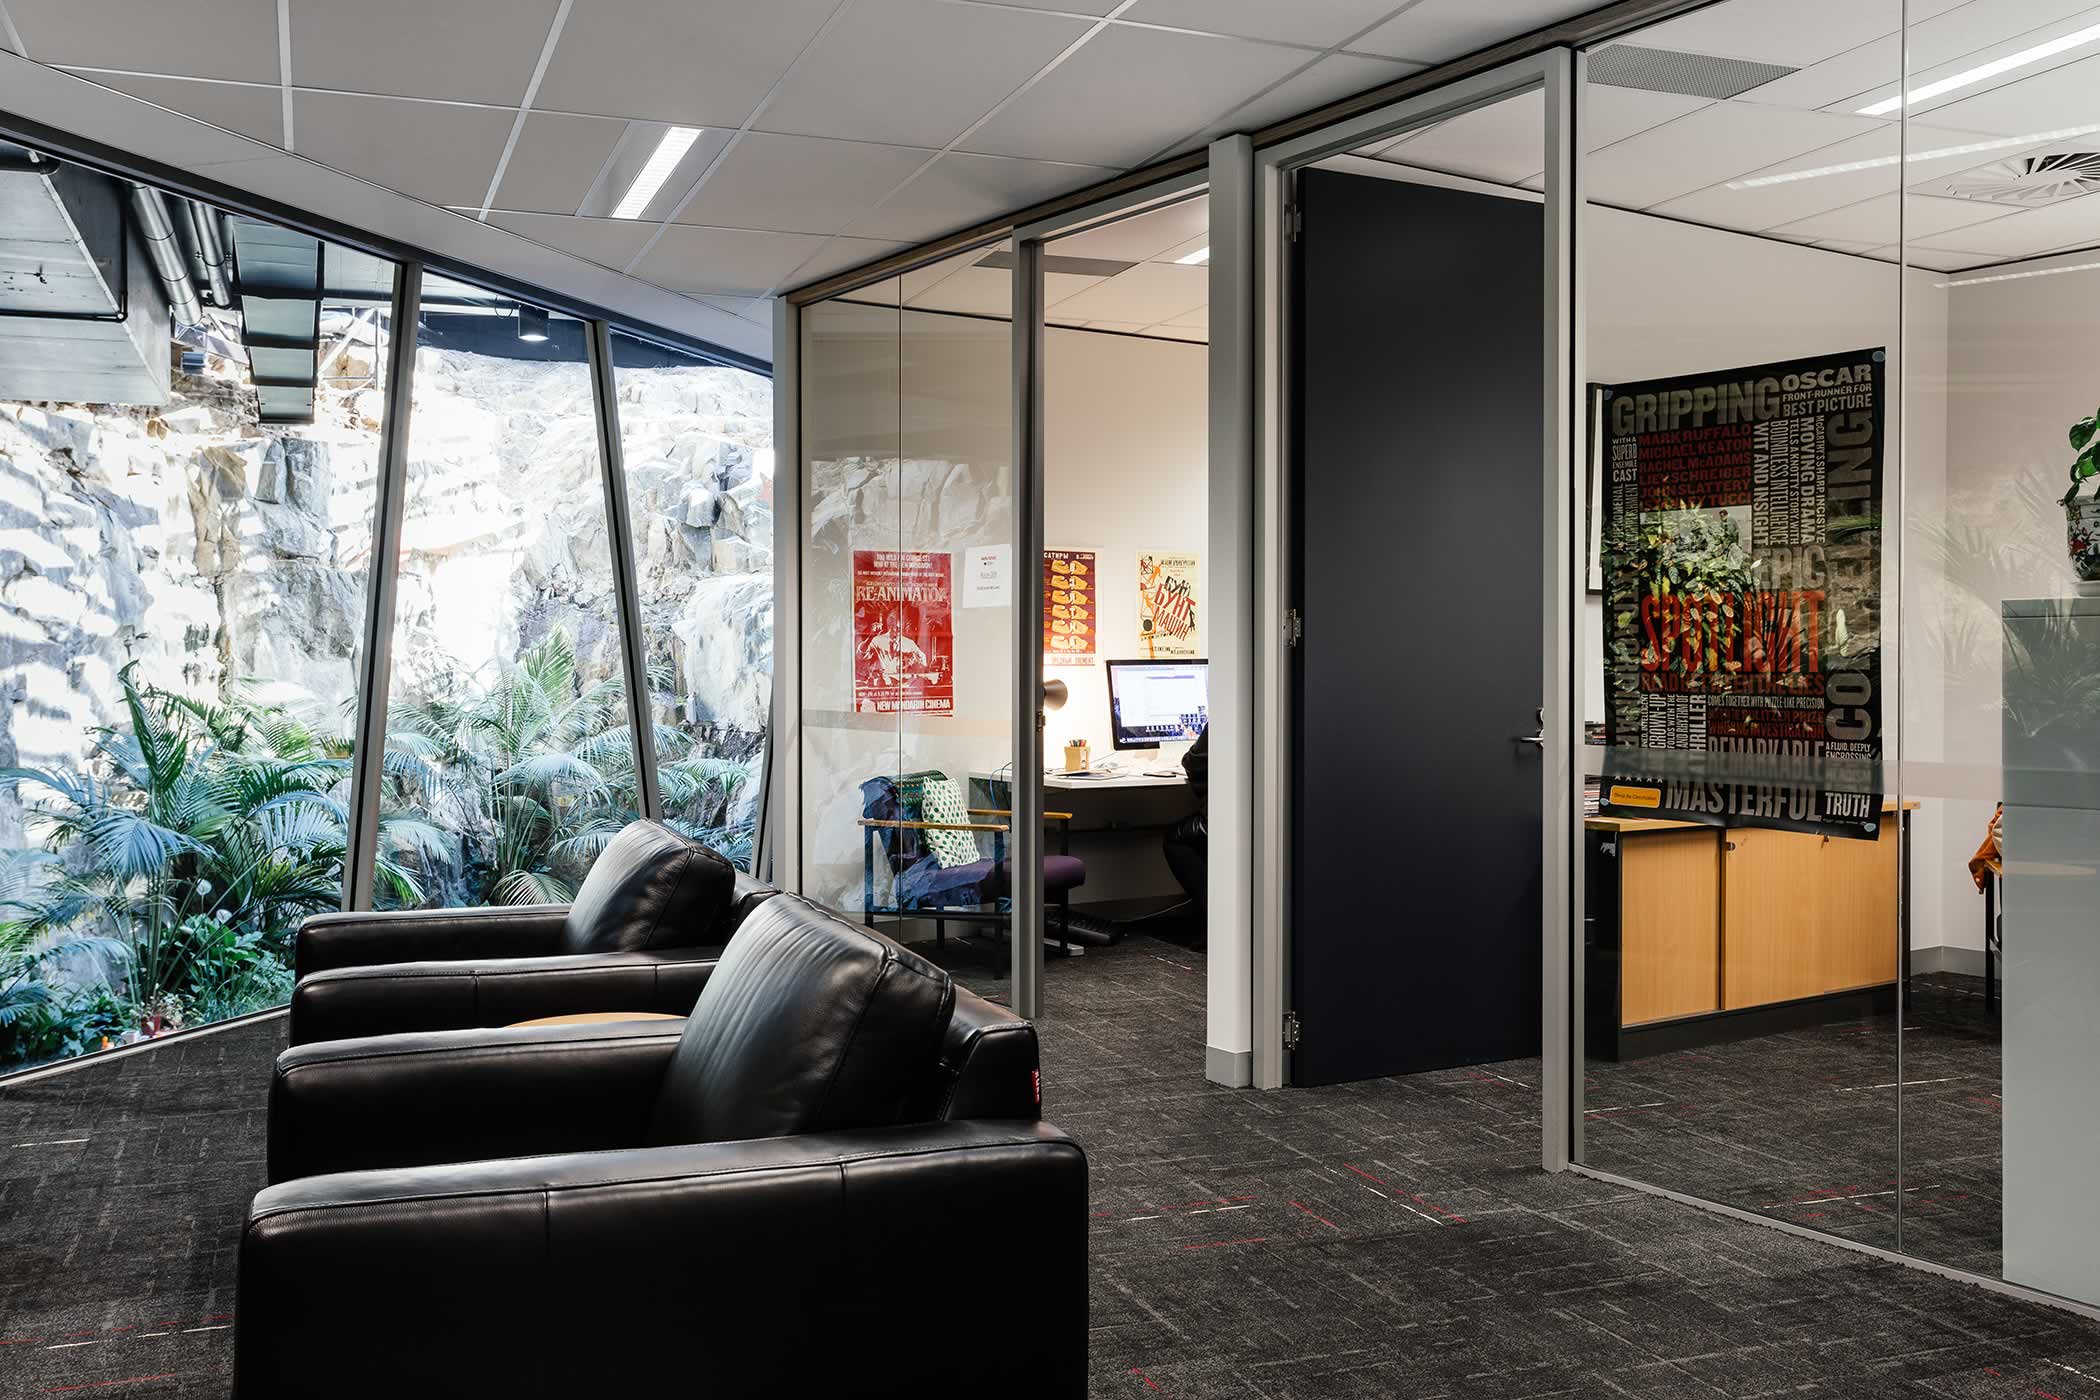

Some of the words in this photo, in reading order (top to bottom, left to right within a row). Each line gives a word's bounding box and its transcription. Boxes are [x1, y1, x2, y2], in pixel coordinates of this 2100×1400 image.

[1782, 364, 1872, 392] OSCAR
[1782, 385, 1852, 402] FRONT-RUNNER
[1854, 383, 1872, 394] FOR
[1783, 399, 1815, 418] BEST
[1816, 393, 1873, 414] PICTURE
[1612, 377, 1780, 437] GRIPPING
[1612, 436, 1632, 445] WITH
[1638, 432, 1680, 445] MARK
[1683, 424, 1751, 442] RUFFALO
[1753, 421, 1769, 451] WIT
[1789, 417, 1799, 445] TELLS
[1638, 443, 1697, 460] MICHAEL
[1697, 437, 1752, 454] KEATON
[1770, 419, 1789, 479] BOUNDLESS
[1800, 416, 1815, 483] MOVING
[1612, 468, 1637, 482] CAST
[1670, 465, 1751, 483] SCHREIBER
[1753, 452, 1769, 484] AND
[1789, 453, 1799, 490] KNOTTY
[1678, 479, 1751, 496] SLATTERY
[1708, 491, 1752, 506] TUCCI
[1753, 486, 1769, 546] INSIGHT
[1770, 479, 1789, 546] INTELLIGENCE
[1800, 485, 1815, 545] DRAMA
[1816, 494, 1826, 544] INCISIVE
[1789, 521, 1799, 545] WITH
[1753, 545, 1826, 590] EPIC
[1154, 582, 1196, 622] БУНТ
[1152, 606, 1191, 641] МАШИН
[1641, 591, 1825, 673] SPOTLIGHT
[1667, 693, 1676, 707] THE
[1649, 693, 1666, 750] GROWN-UP
[1667, 707, 1676, 727] WITH
[1676, 733, 1689, 749] AND
[1850, 742, 1871, 753] DEEPLY
[1665, 777, 1822, 822] MASTERFUL
[1825, 791, 1871, 819] TRUTH
